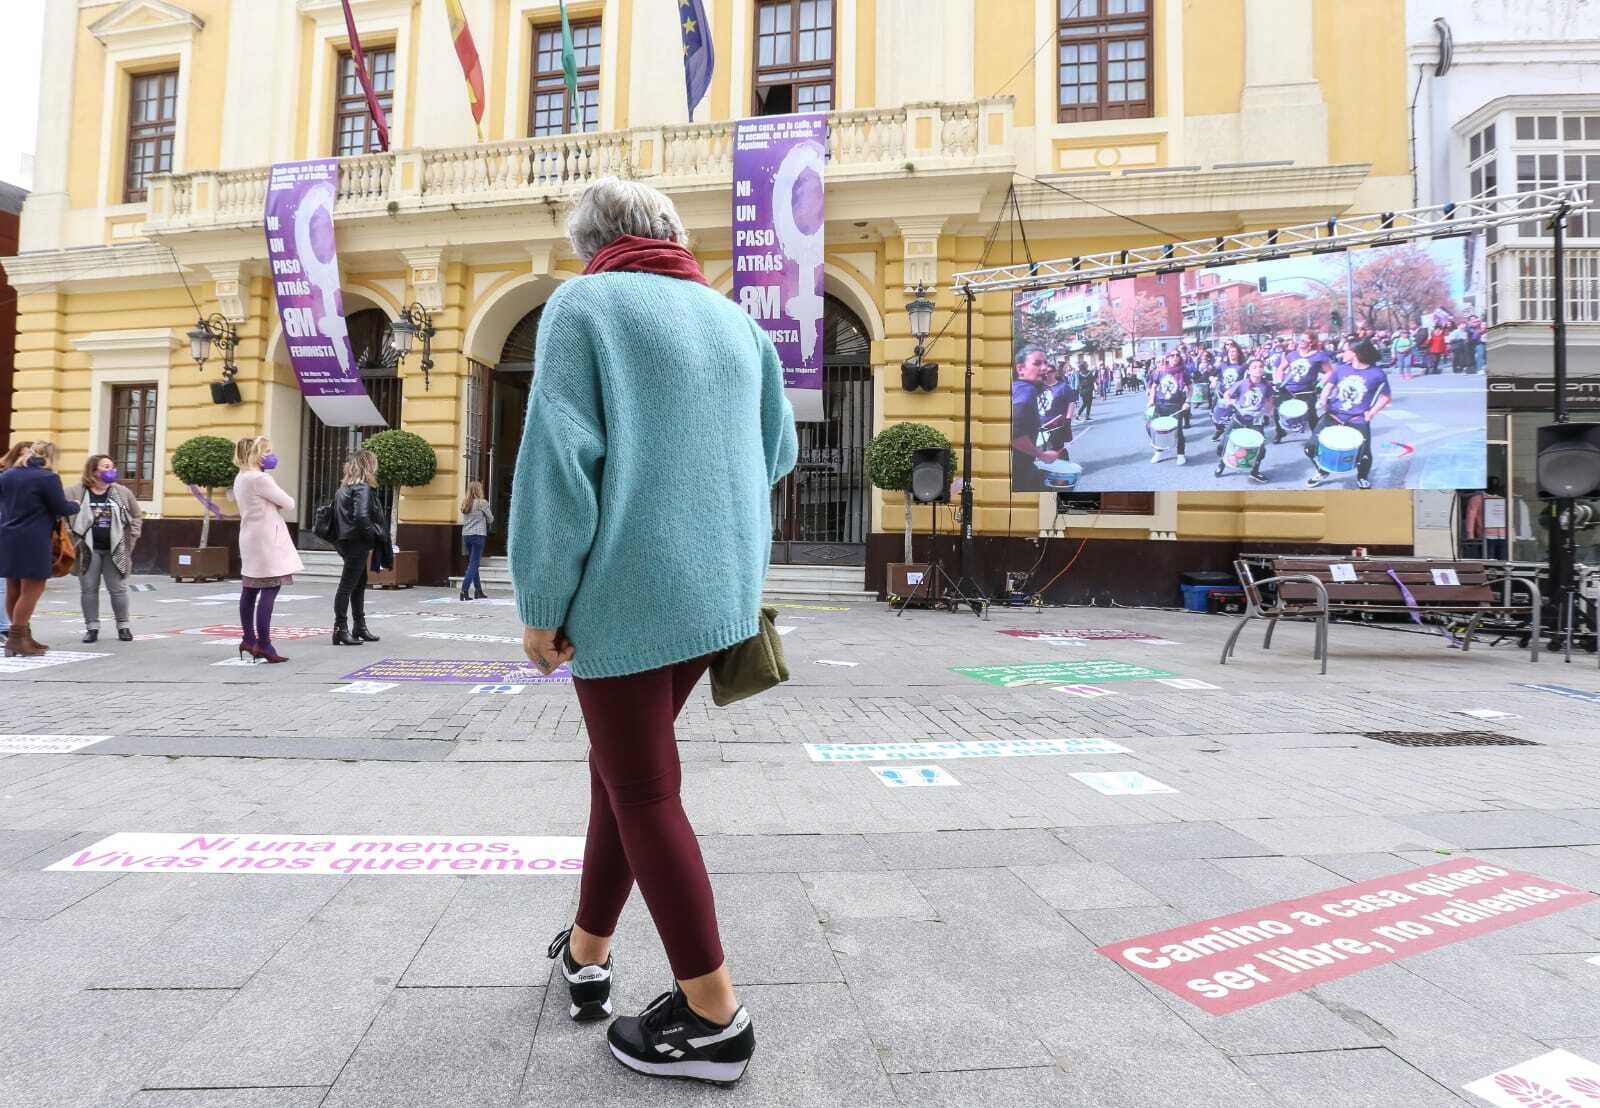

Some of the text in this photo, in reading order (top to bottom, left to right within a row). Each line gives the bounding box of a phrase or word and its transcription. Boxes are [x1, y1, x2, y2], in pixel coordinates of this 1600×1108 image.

[736, 180, 751, 197] NI
[736, 205, 756, 221] UN
[266, 216, 279, 231] NI
[269, 237, 285, 253] UN
[736, 229, 775, 247] PASO
[272, 259, 301, 275] PASO
[736, 251, 783, 272] ATRÁS
[276, 278, 311, 296] ATRÁS
[739, 285, 781, 320] 8M
[283, 307, 317, 338] 8M
[177, 836, 521, 856] Ni una menos,
[72, 851, 583, 873] Vivas nos queremos
[1122, 865, 1510, 969] Camino a casa quiero
[1186, 886, 1571, 998] ser libre, no valiente.
